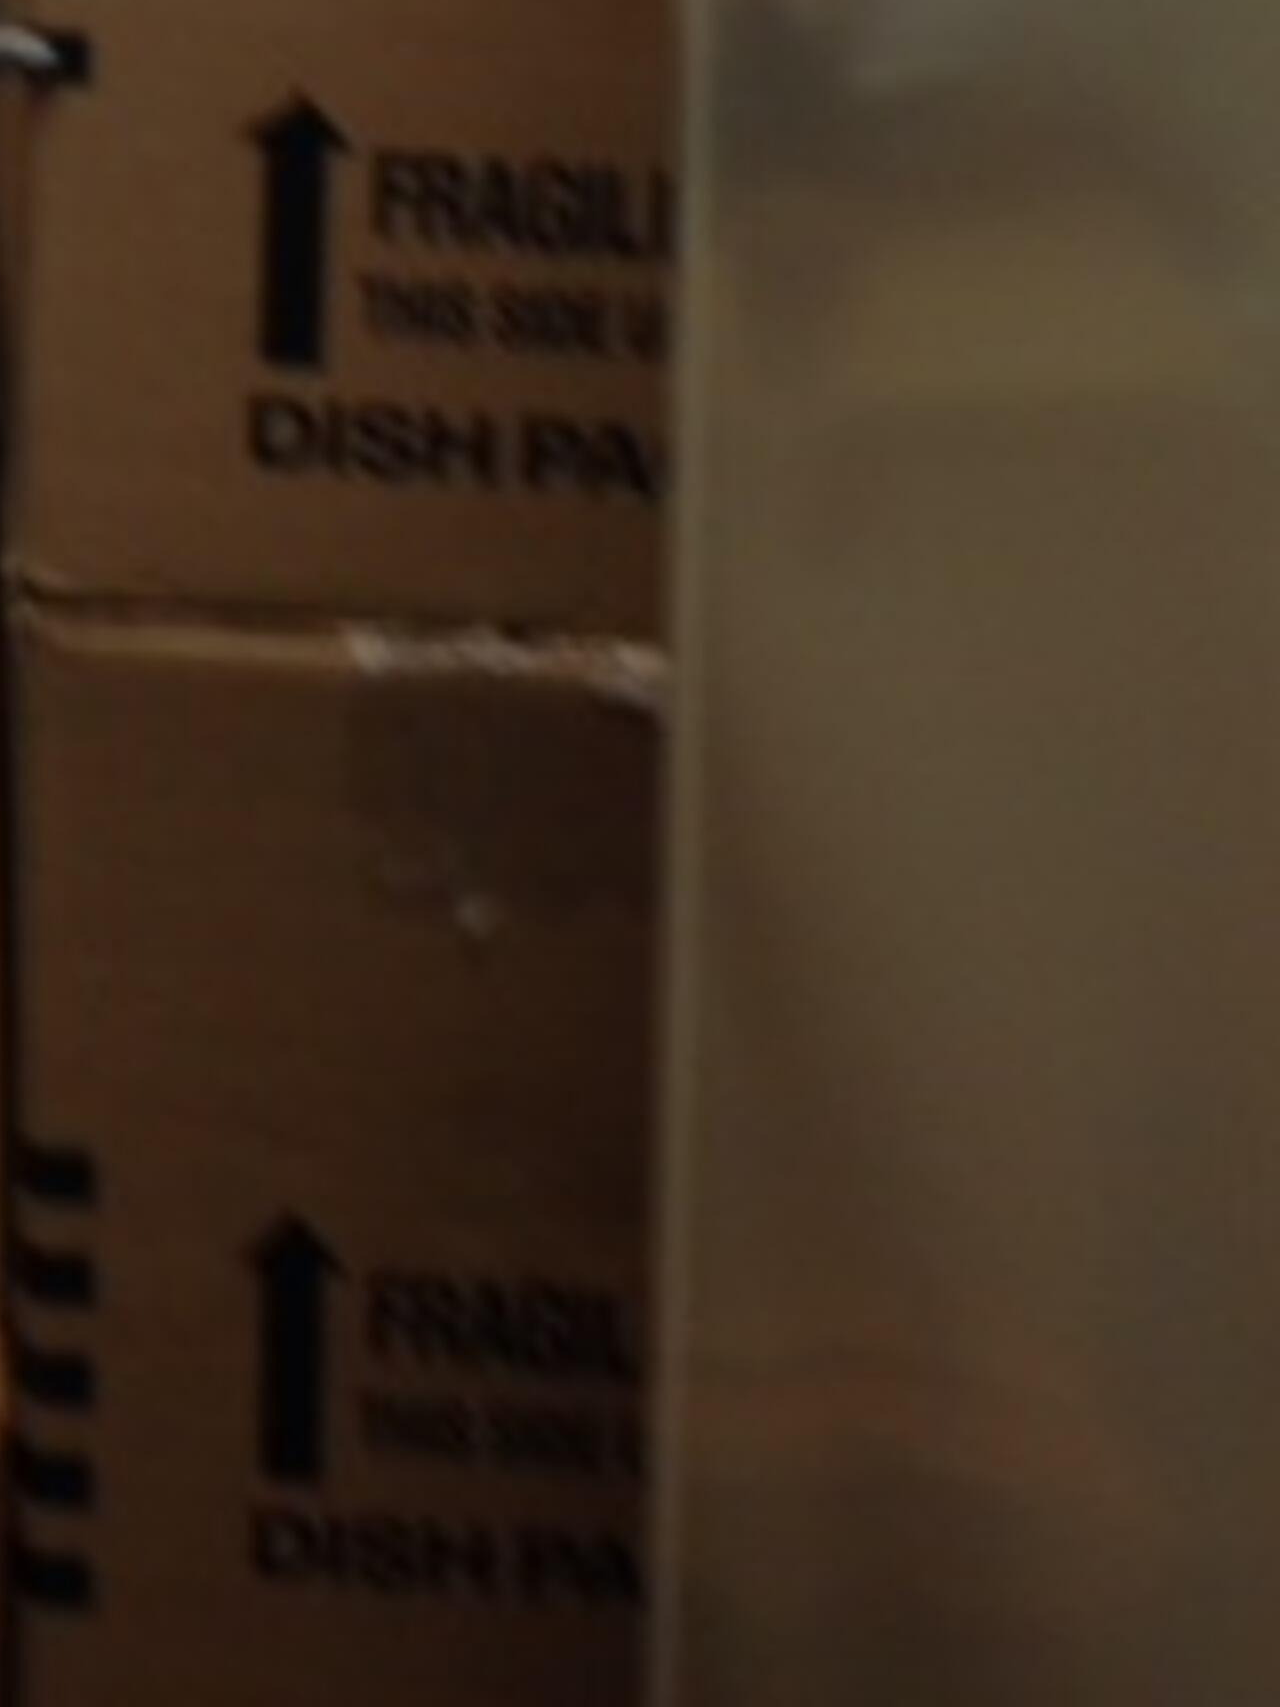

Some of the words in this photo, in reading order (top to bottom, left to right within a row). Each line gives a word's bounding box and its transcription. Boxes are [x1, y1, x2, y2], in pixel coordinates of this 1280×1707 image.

[246, 390, 501, 492] DISH
[364, 1268, 643, 1384] FRAGIL
[515, 1522, 648, 1611] PA
